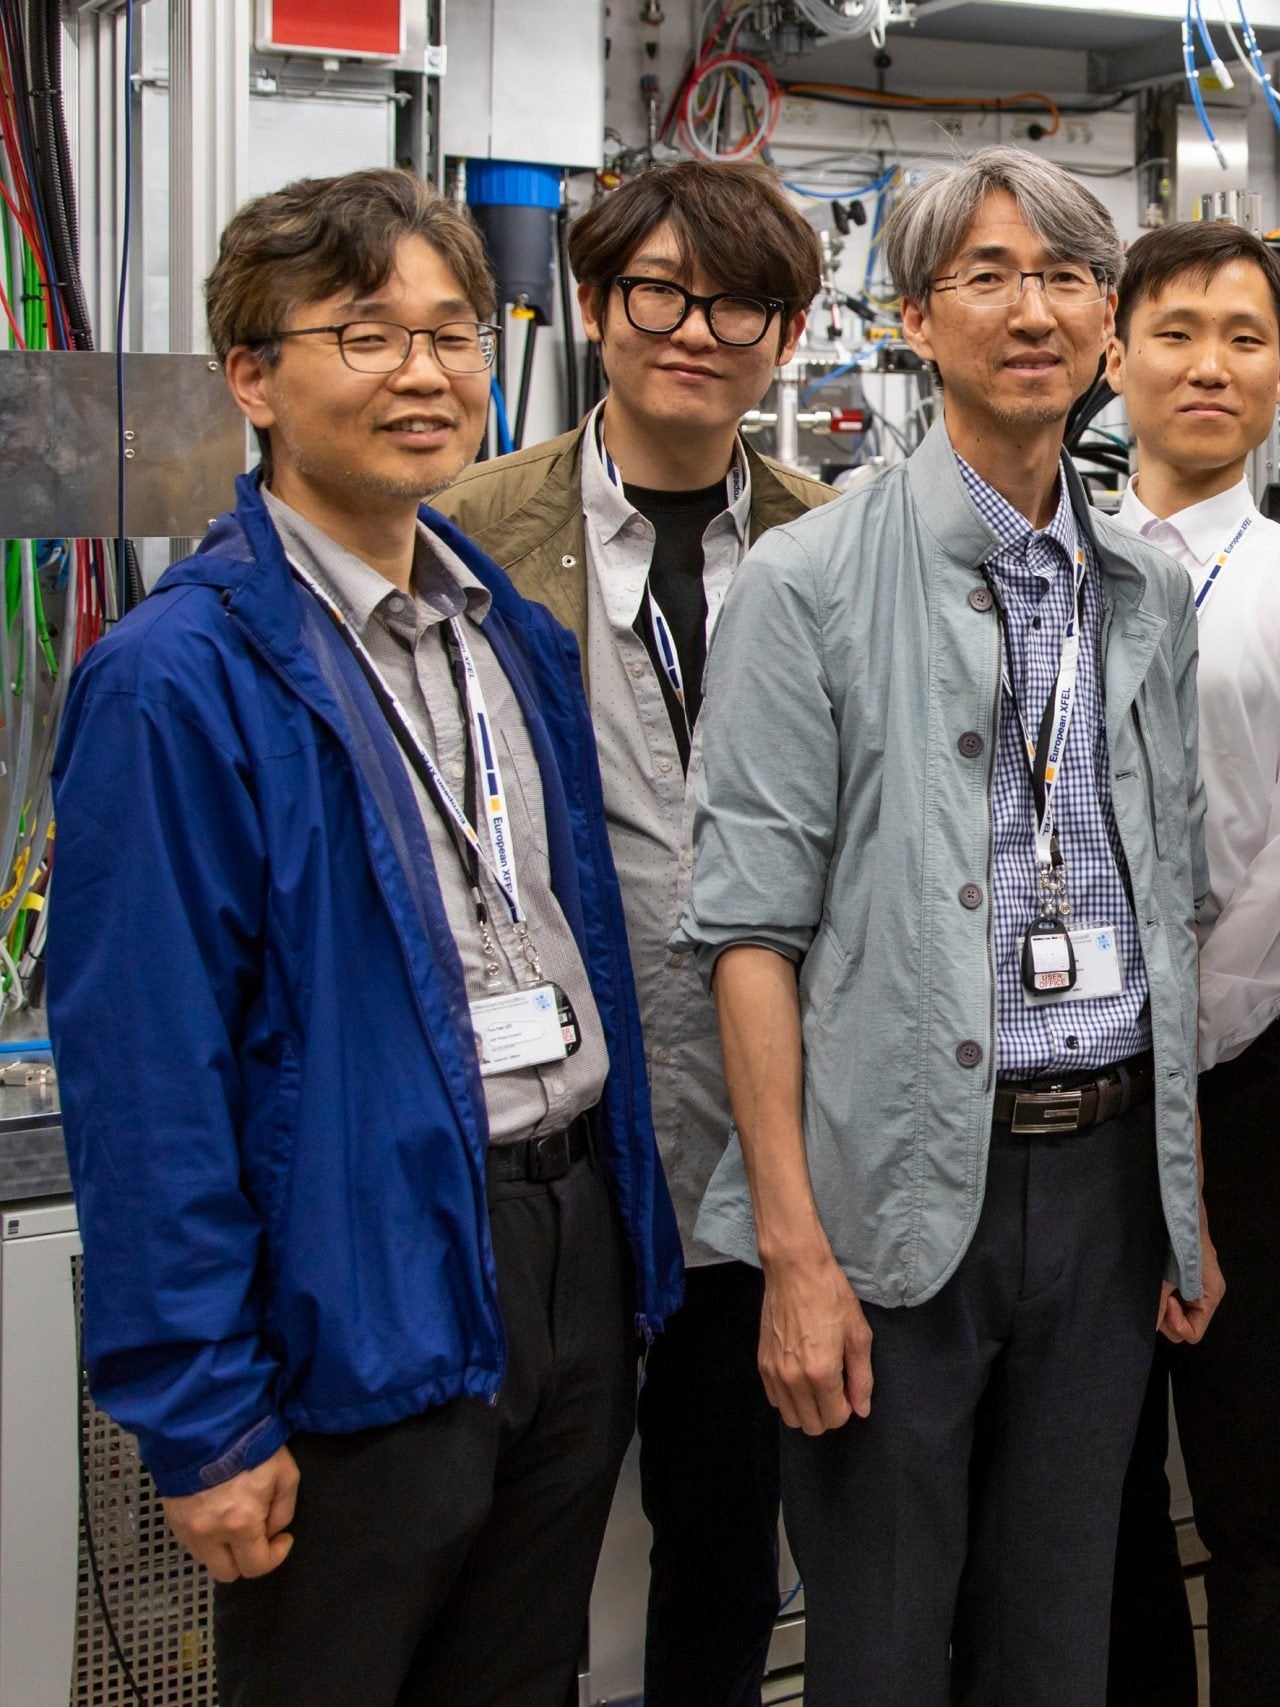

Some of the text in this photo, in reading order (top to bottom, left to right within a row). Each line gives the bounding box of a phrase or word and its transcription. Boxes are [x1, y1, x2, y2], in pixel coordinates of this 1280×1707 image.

[1049, 687, 1071, 764] European XFEL
[493, 816, 508, 871] European
[1039, 979, 1066, 988] OFFICE
[1041, 973, 1063, 982] USER
